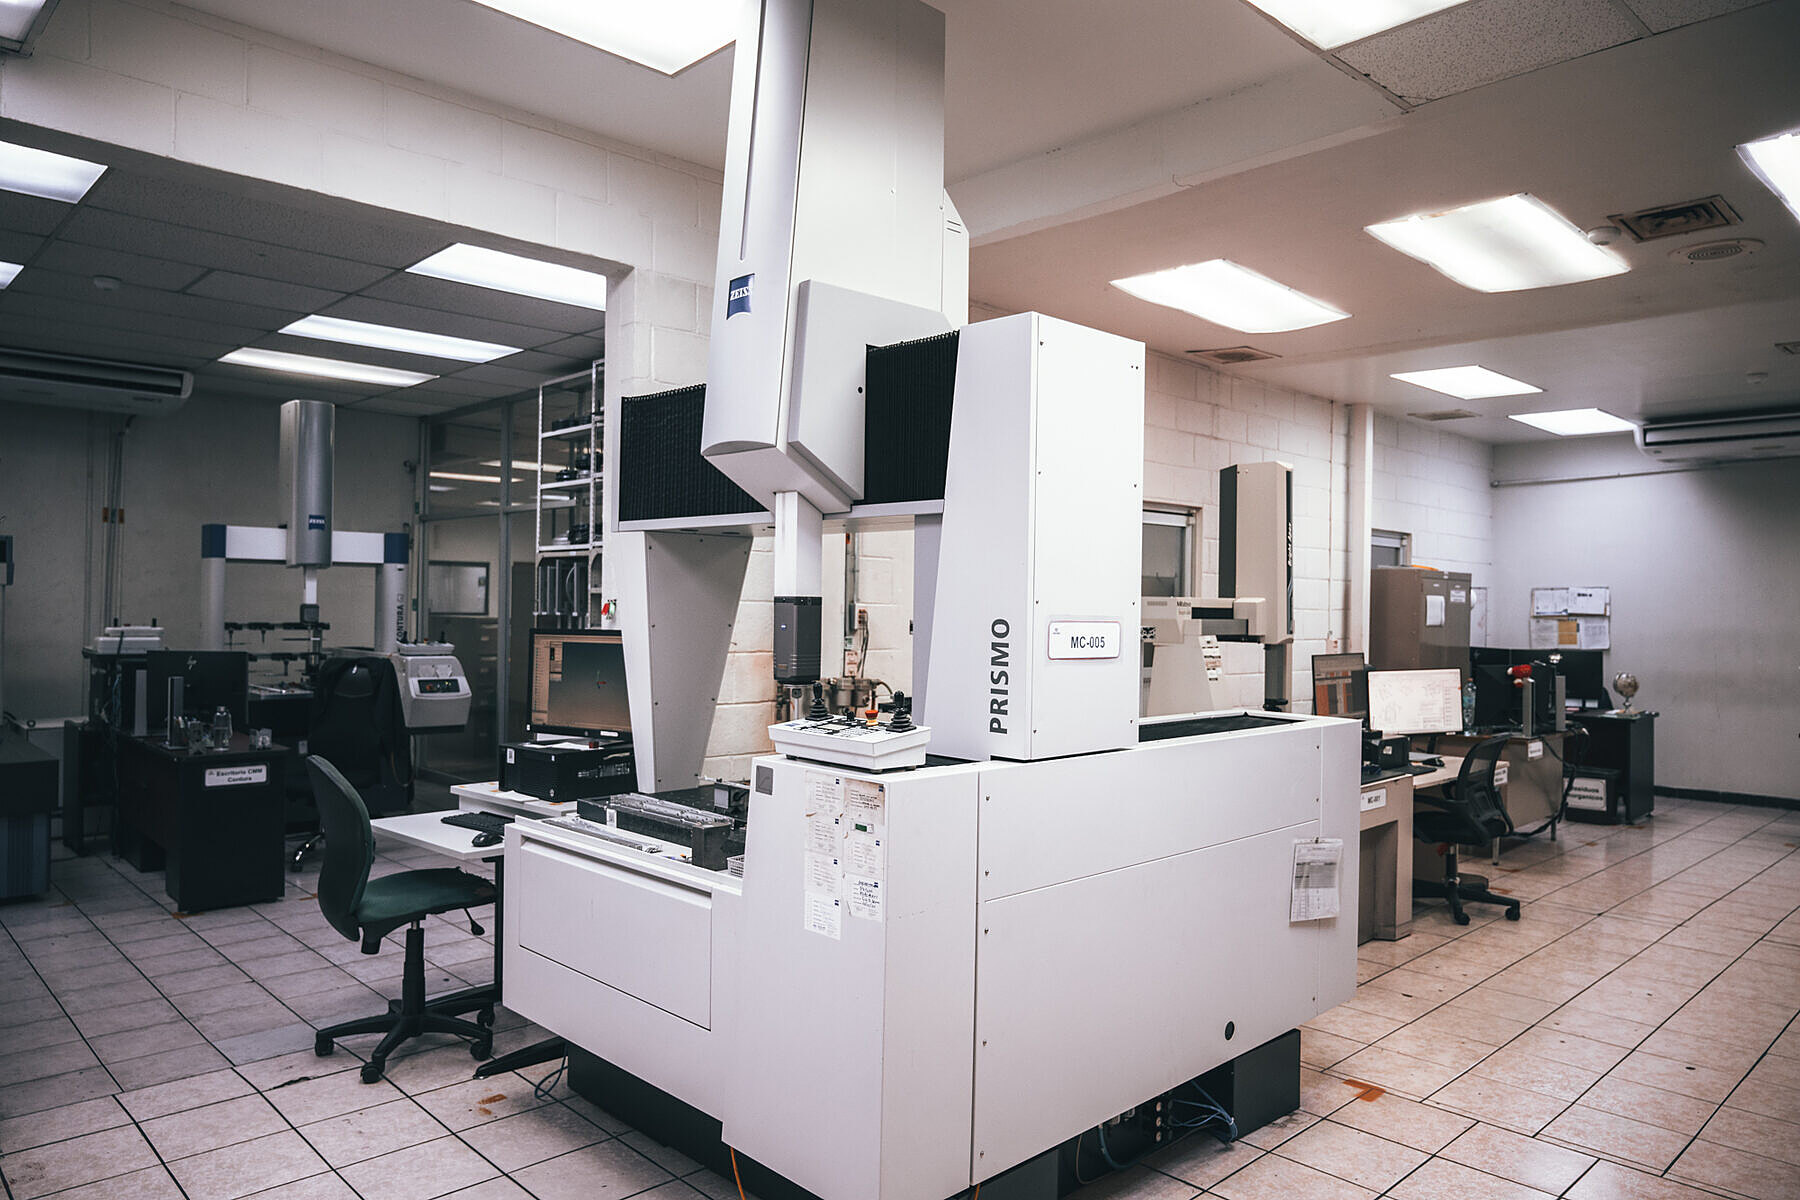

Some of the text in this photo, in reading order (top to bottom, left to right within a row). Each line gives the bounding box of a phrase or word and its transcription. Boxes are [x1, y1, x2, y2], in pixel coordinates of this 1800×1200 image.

[730, 286, 751, 300] ZEISS
[1070, 636, 1106, 649] MC-005
[989, 618, 1010, 735] PRISMO
